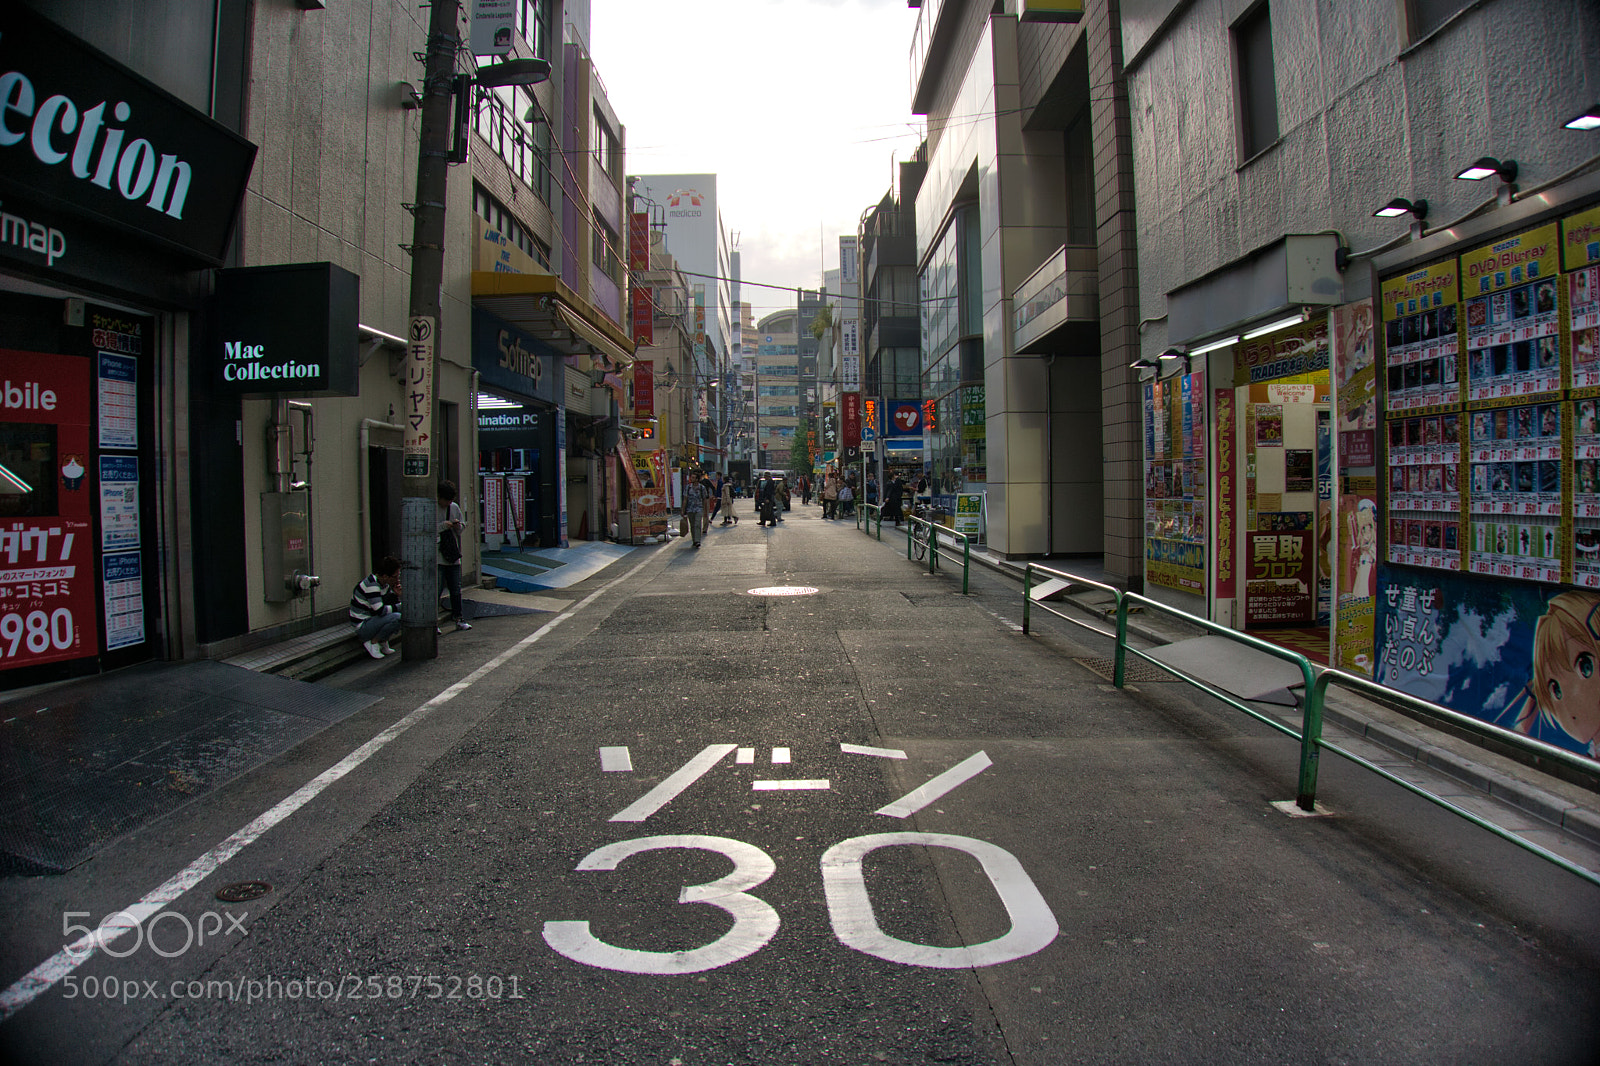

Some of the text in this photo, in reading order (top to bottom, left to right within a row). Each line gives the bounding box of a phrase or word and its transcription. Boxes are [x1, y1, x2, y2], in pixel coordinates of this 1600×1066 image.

[0, 71, 192, 220] ection
[0, 211, 66, 267] map
[223, 360, 321, 382] Collection
[224, 342, 264, 360] Mac
[498, 329, 542, 390] Sofmap
[0, 380, 58, 411] bile
[409, 345, 426, 431] モリヤマ
[865, 400, 874, 430] 電子パー
[522, 414, 538, 424] PC
[1253, 535, 1304, 562] 買取
[1254, 562, 1302, 578] フロア
[1384, 584, 1400, 680] せいだ。
[1400, 585, 1418, 670] 童貞の
[1416, 588, 1436, 676] ぜんぶ
[600, 743, 993, 822] ゾーン
[542, 832, 1060, 974] 30
